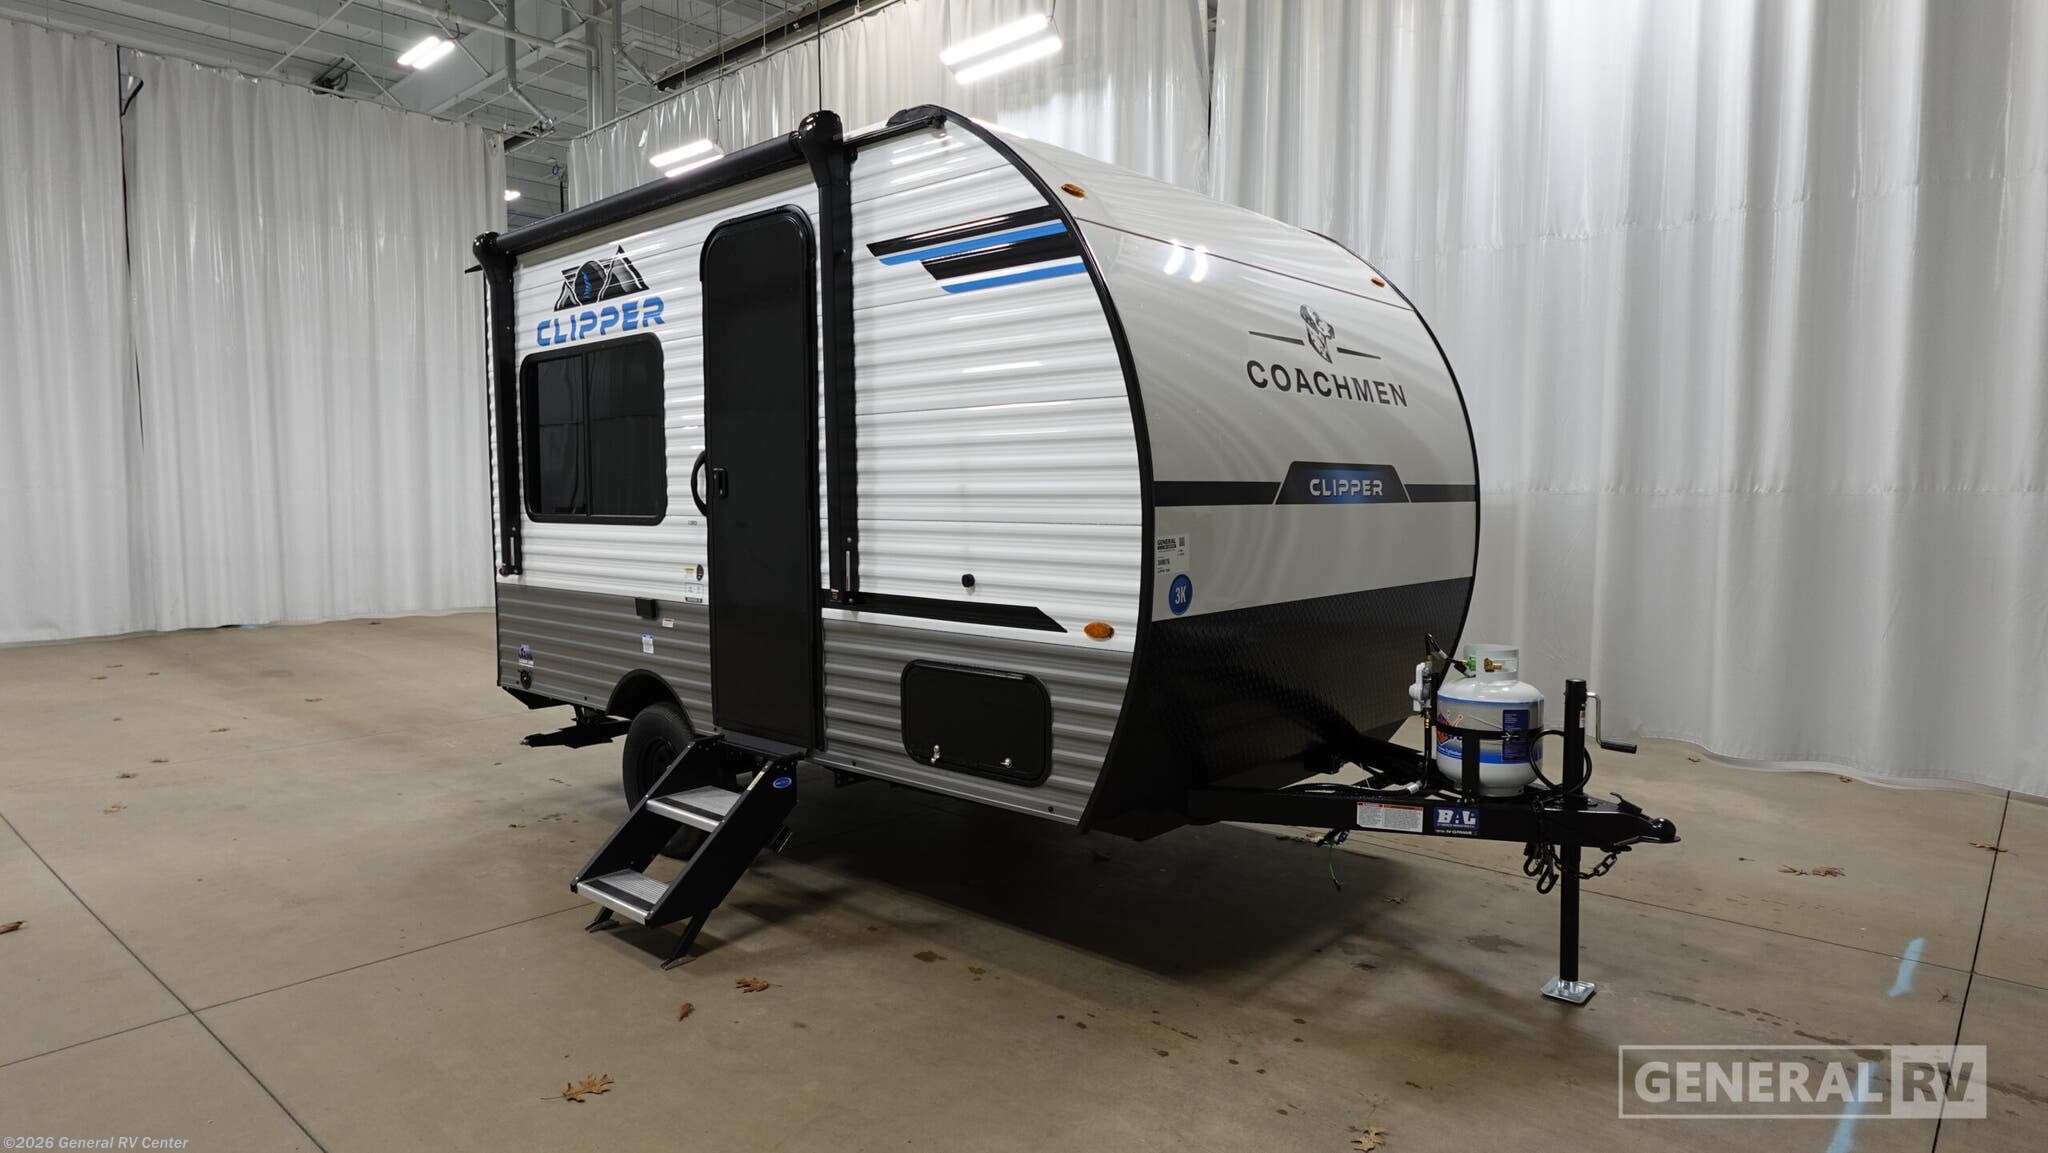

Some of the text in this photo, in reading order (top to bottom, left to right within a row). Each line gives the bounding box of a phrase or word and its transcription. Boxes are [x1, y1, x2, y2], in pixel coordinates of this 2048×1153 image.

[536, 297, 665, 347] CLIPPER
[1246, 360, 1408, 407] COACHMEN
[1309, 477, 1384, 497] CLIPPER
[1174, 586, 1187, 605] 3K
